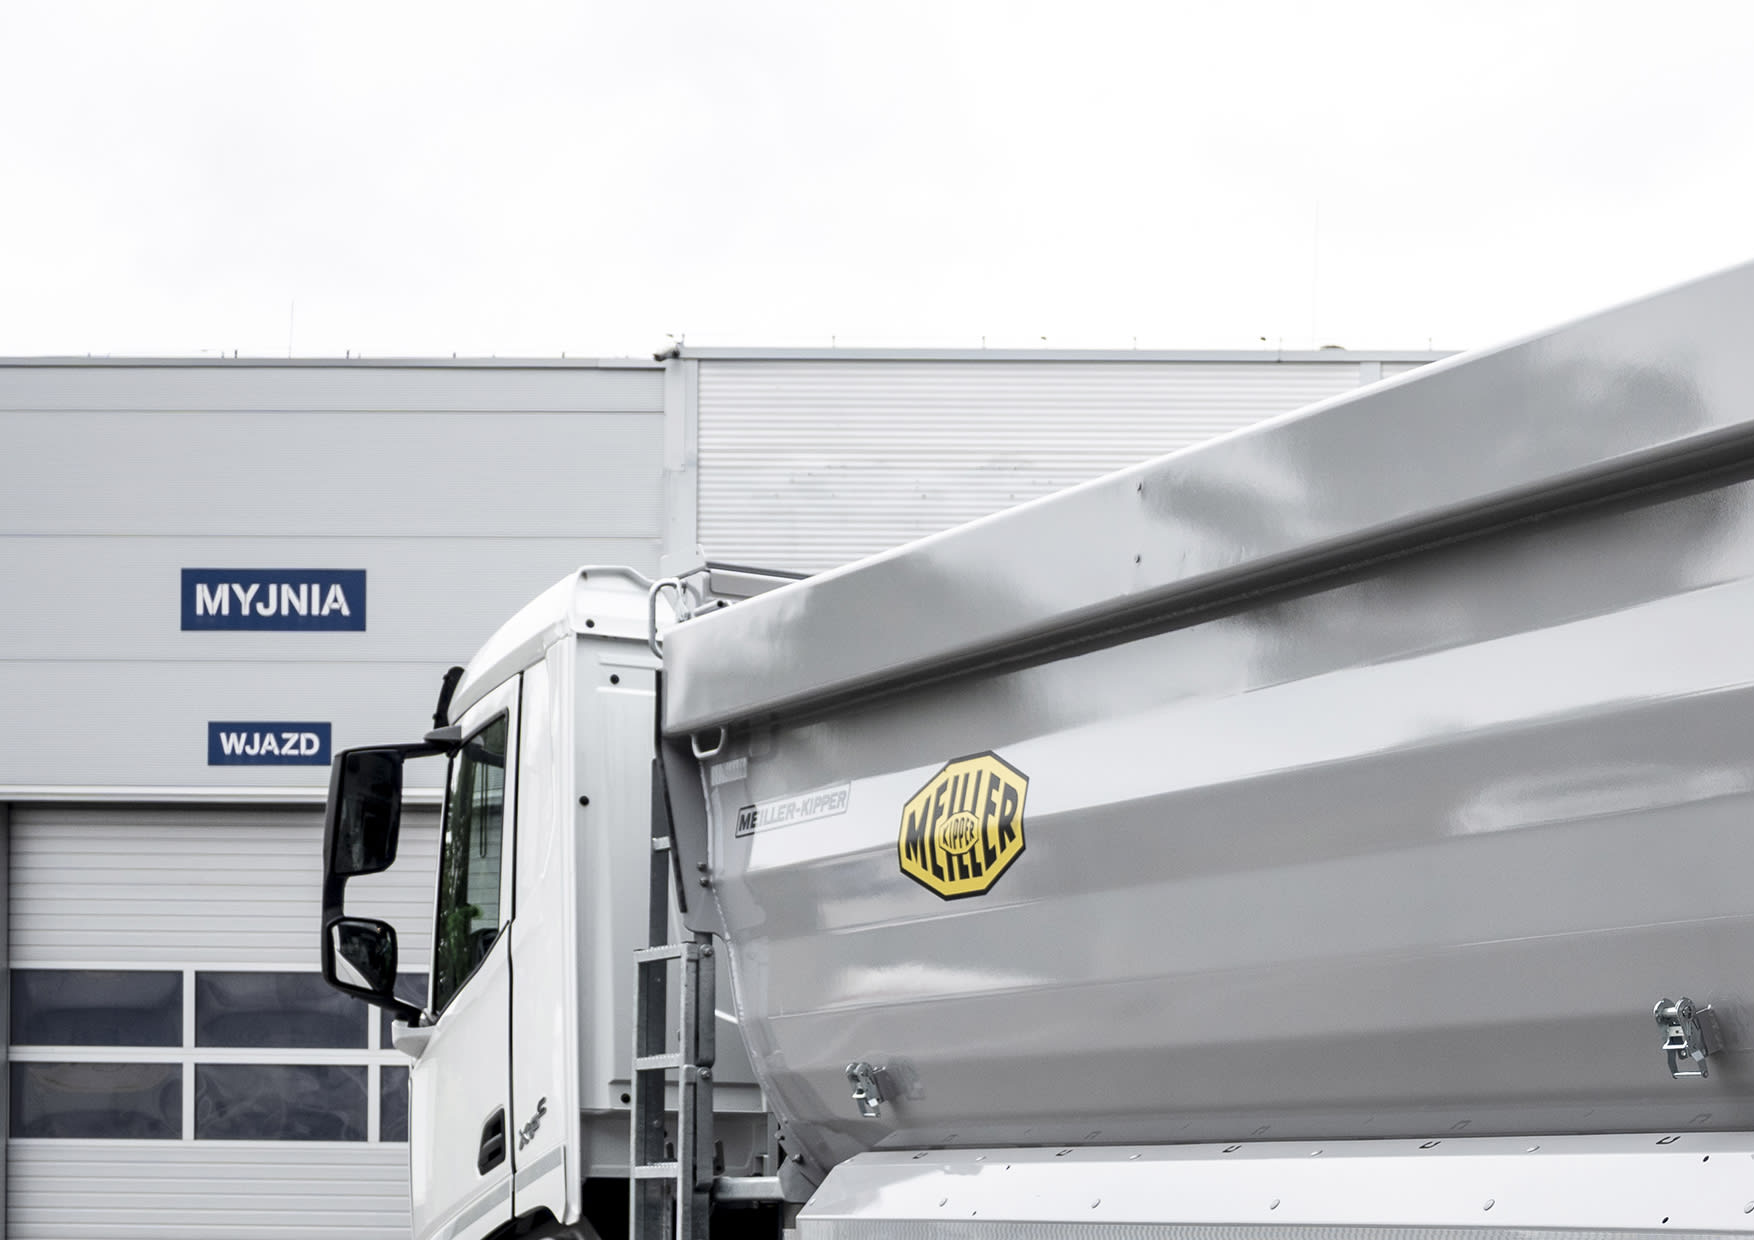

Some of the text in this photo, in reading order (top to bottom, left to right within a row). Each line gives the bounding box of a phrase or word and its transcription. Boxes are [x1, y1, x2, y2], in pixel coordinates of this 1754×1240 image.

[195, 583, 350, 616] MYJNIA
[219, 731, 320, 756] WJAZD
[738, 790, 847, 832] MEILLER-KIPPER
[905, 768, 1019, 883] MEILLER
[942, 817, 976, 851] KIPPER
